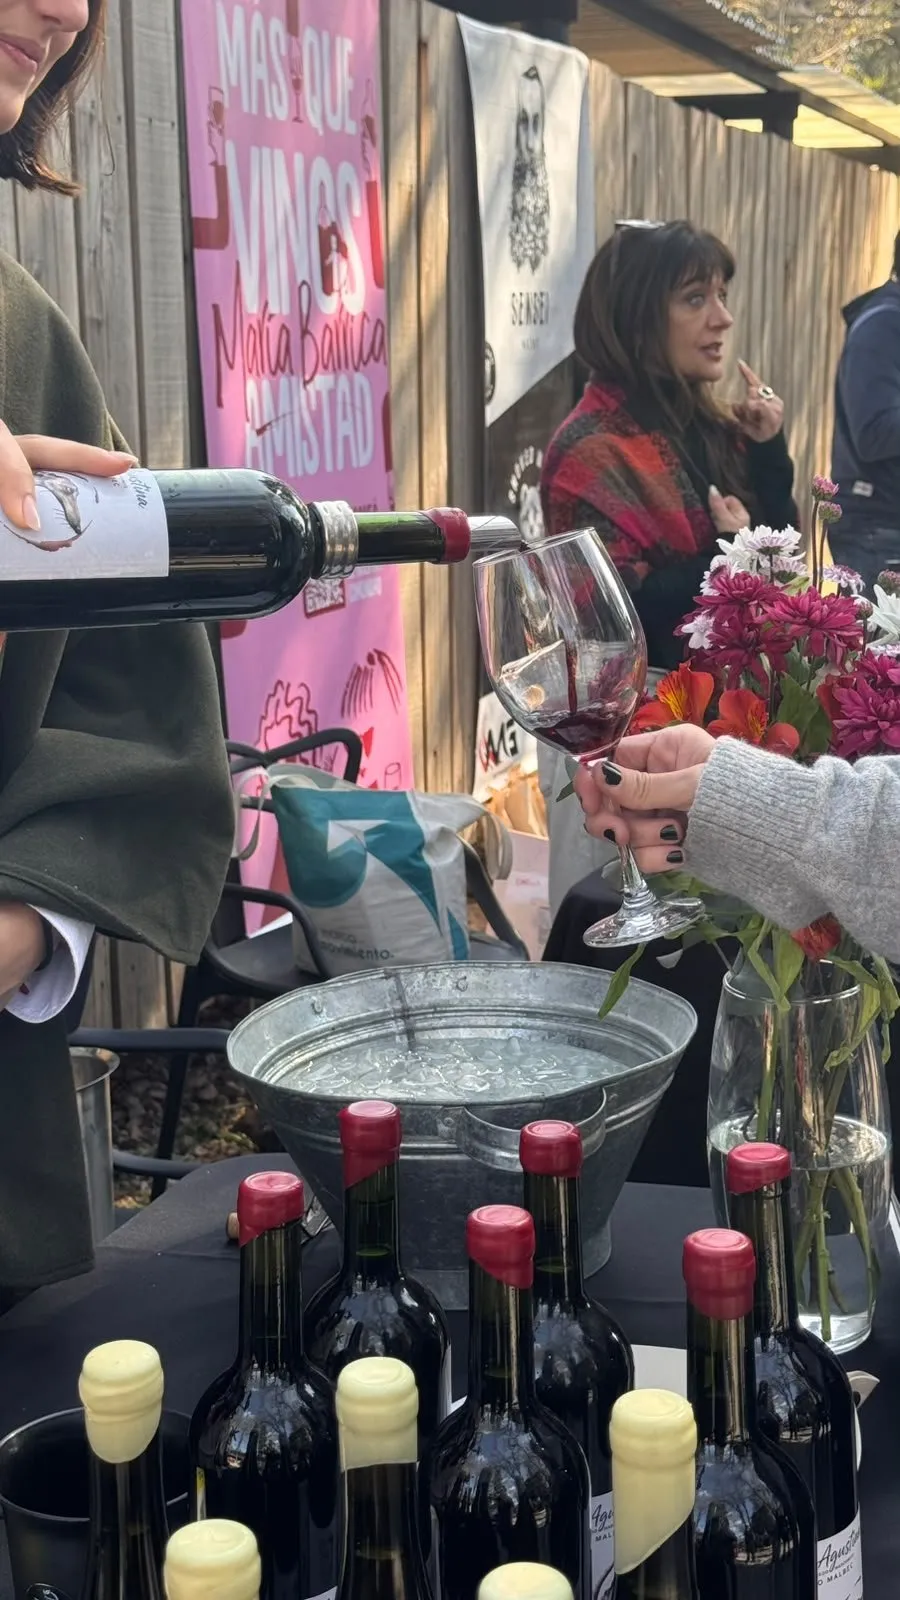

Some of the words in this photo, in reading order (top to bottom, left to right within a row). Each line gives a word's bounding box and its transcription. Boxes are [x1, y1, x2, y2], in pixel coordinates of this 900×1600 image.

[303, 25, 357, 136] QUE
[225, 139, 365, 315] VINOS
[298, 280, 387, 389] Barrica
[511, 291, 549, 326] SENSEI
[245, 372, 374, 477] AMISTAD
[595, 1532, 612, 1542] MAL
[826, 1561, 854, 1583] MALBEC
